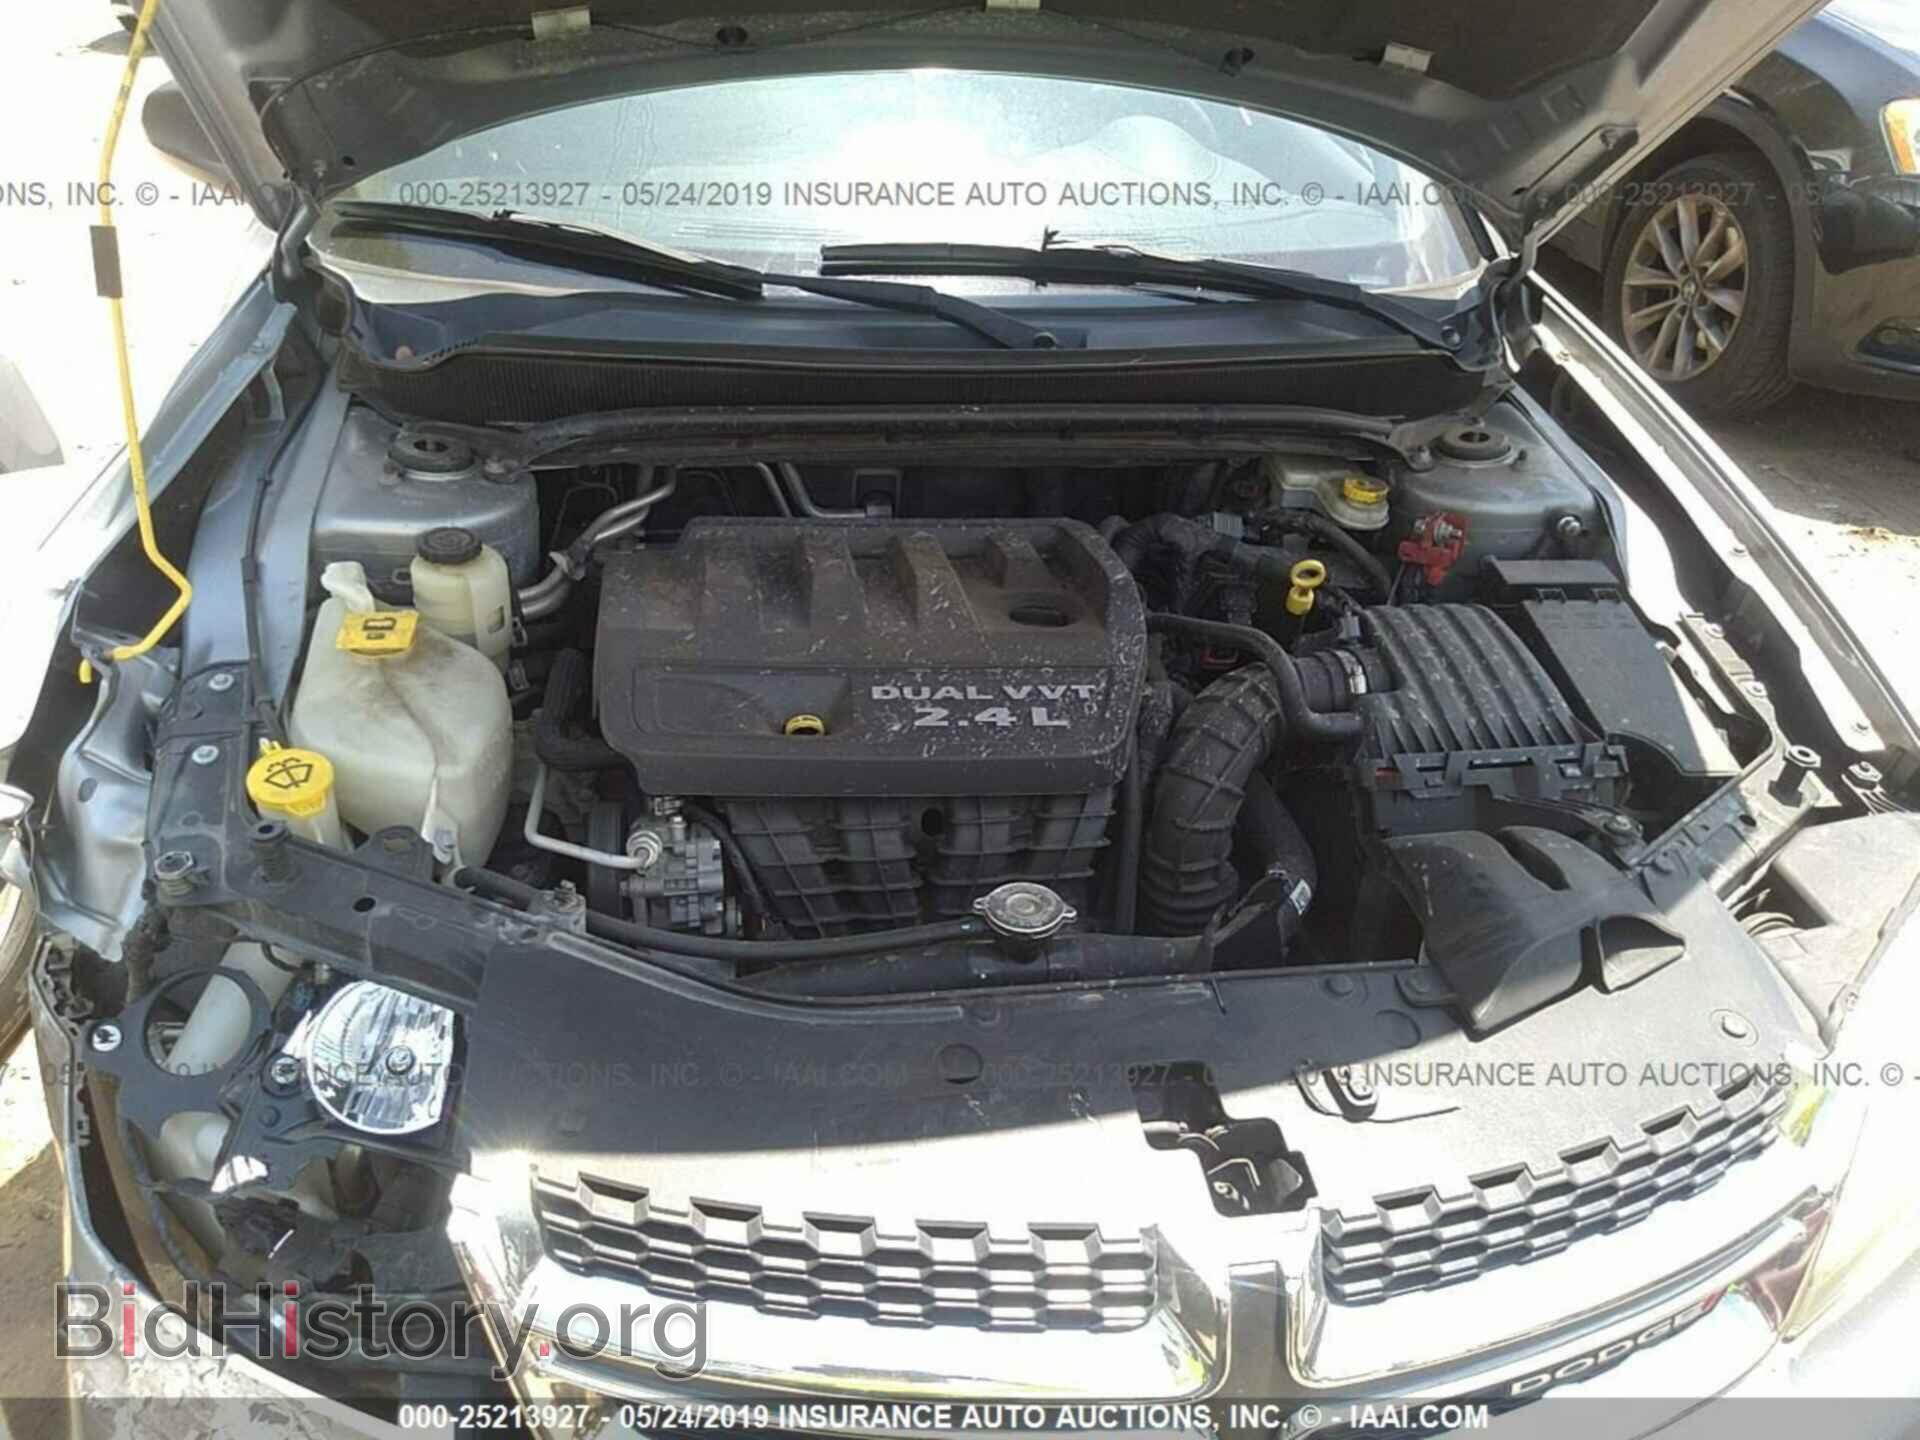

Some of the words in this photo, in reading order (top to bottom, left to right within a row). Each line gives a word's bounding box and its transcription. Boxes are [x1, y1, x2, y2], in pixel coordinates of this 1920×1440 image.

[871, 685, 994, 701] DUAL
[1002, 684, 1096, 701] VVT
[1510, 1300, 1706, 1397] DODGE
